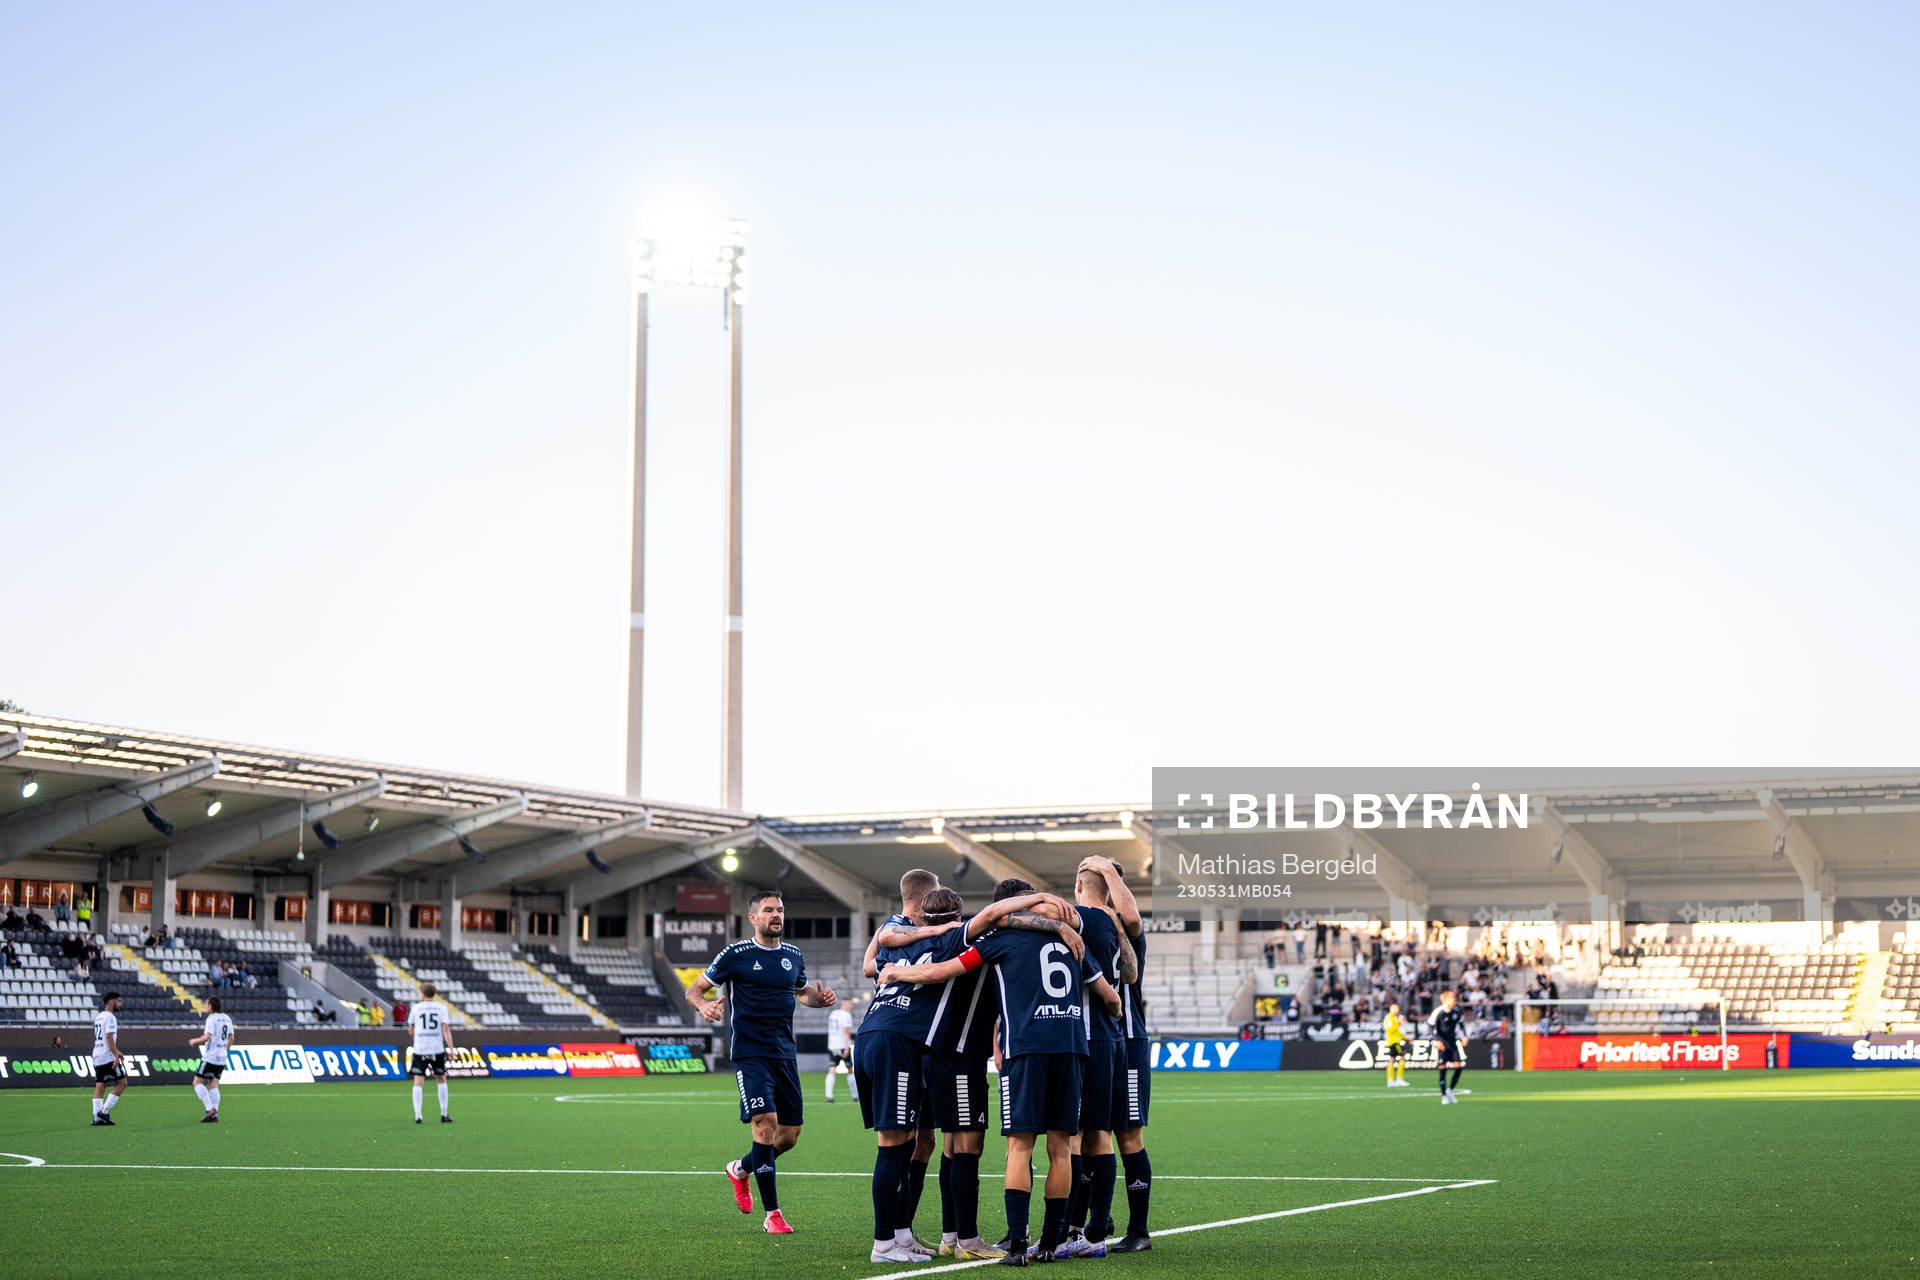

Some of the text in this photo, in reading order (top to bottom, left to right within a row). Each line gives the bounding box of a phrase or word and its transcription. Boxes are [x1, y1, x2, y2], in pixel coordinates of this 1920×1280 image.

[1040, 942, 1072, 998] 6
[1033, 1004, 1081, 1016] ANLAB
[419, 1013, 438, 1030] 15
[221, 1025, 228, 1041] 8
[1580, 1041, 1671, 1062] Prioritet
[305, 1051, 400, 1077] BRIXLY
[750, 1097, 765, 1109] 23
[978, 1112, 986, 1124] 4
